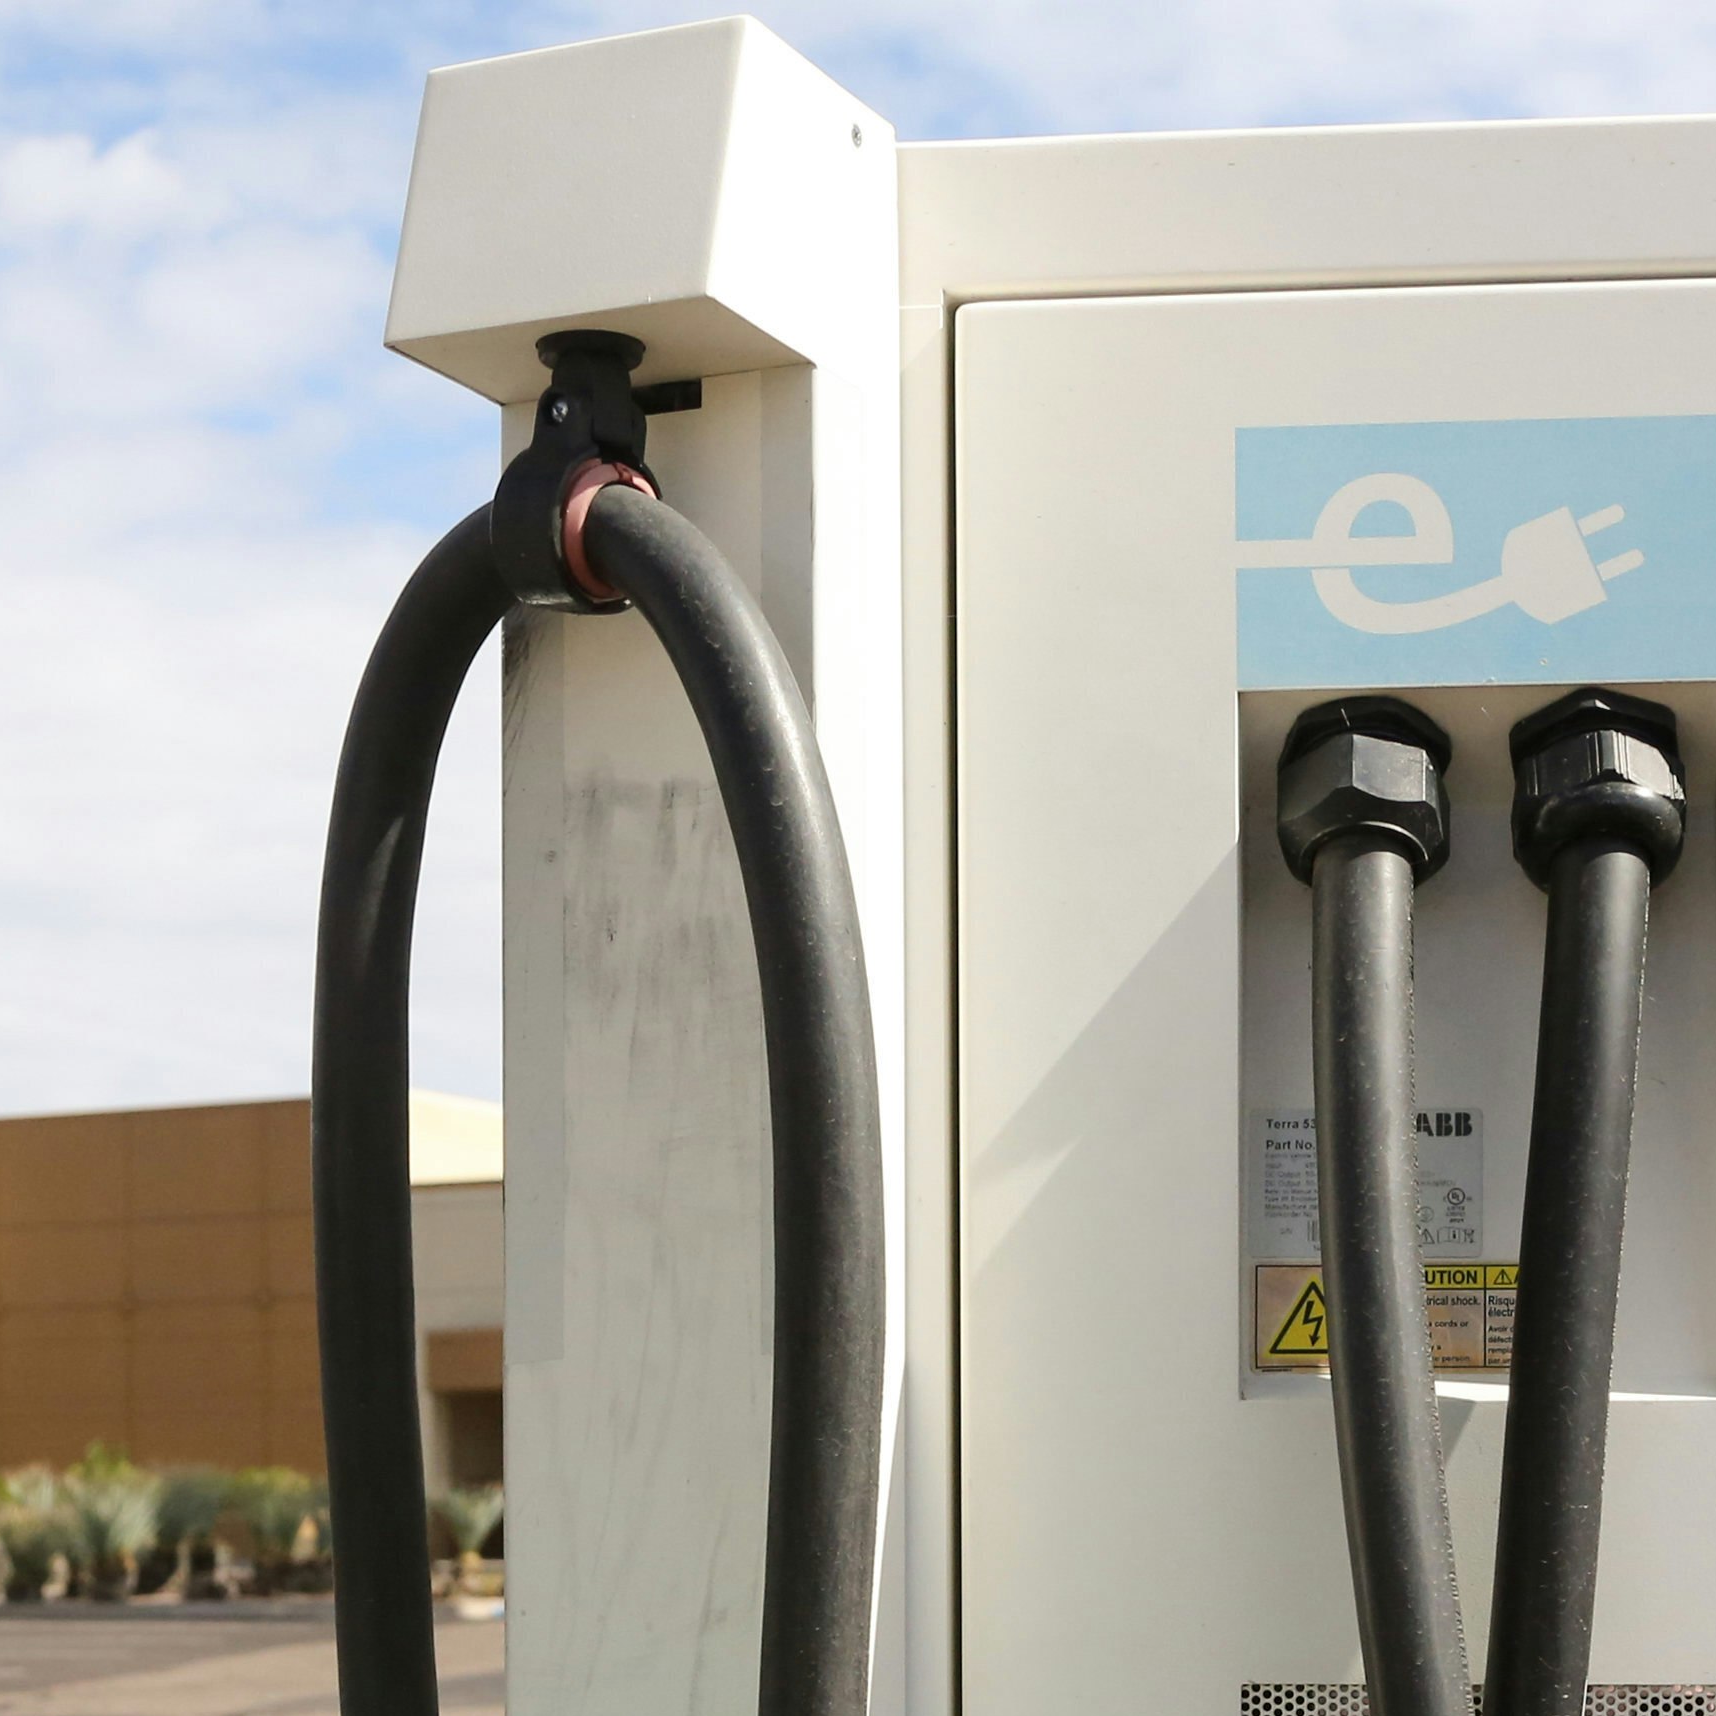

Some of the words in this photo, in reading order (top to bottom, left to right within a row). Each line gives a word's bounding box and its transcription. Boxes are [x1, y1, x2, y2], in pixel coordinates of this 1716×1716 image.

[1266, 1118, 1299, 1129] Terra
[1417, 1112, 1472, 1136] ABB
[1266, 1139, 1291, 1150] Part
[1425, 1270, 1478, 1285] UTION
[1426, 1295, 1449, 1306] trical
[1488, 1295, 1515, 1309] Risqu
